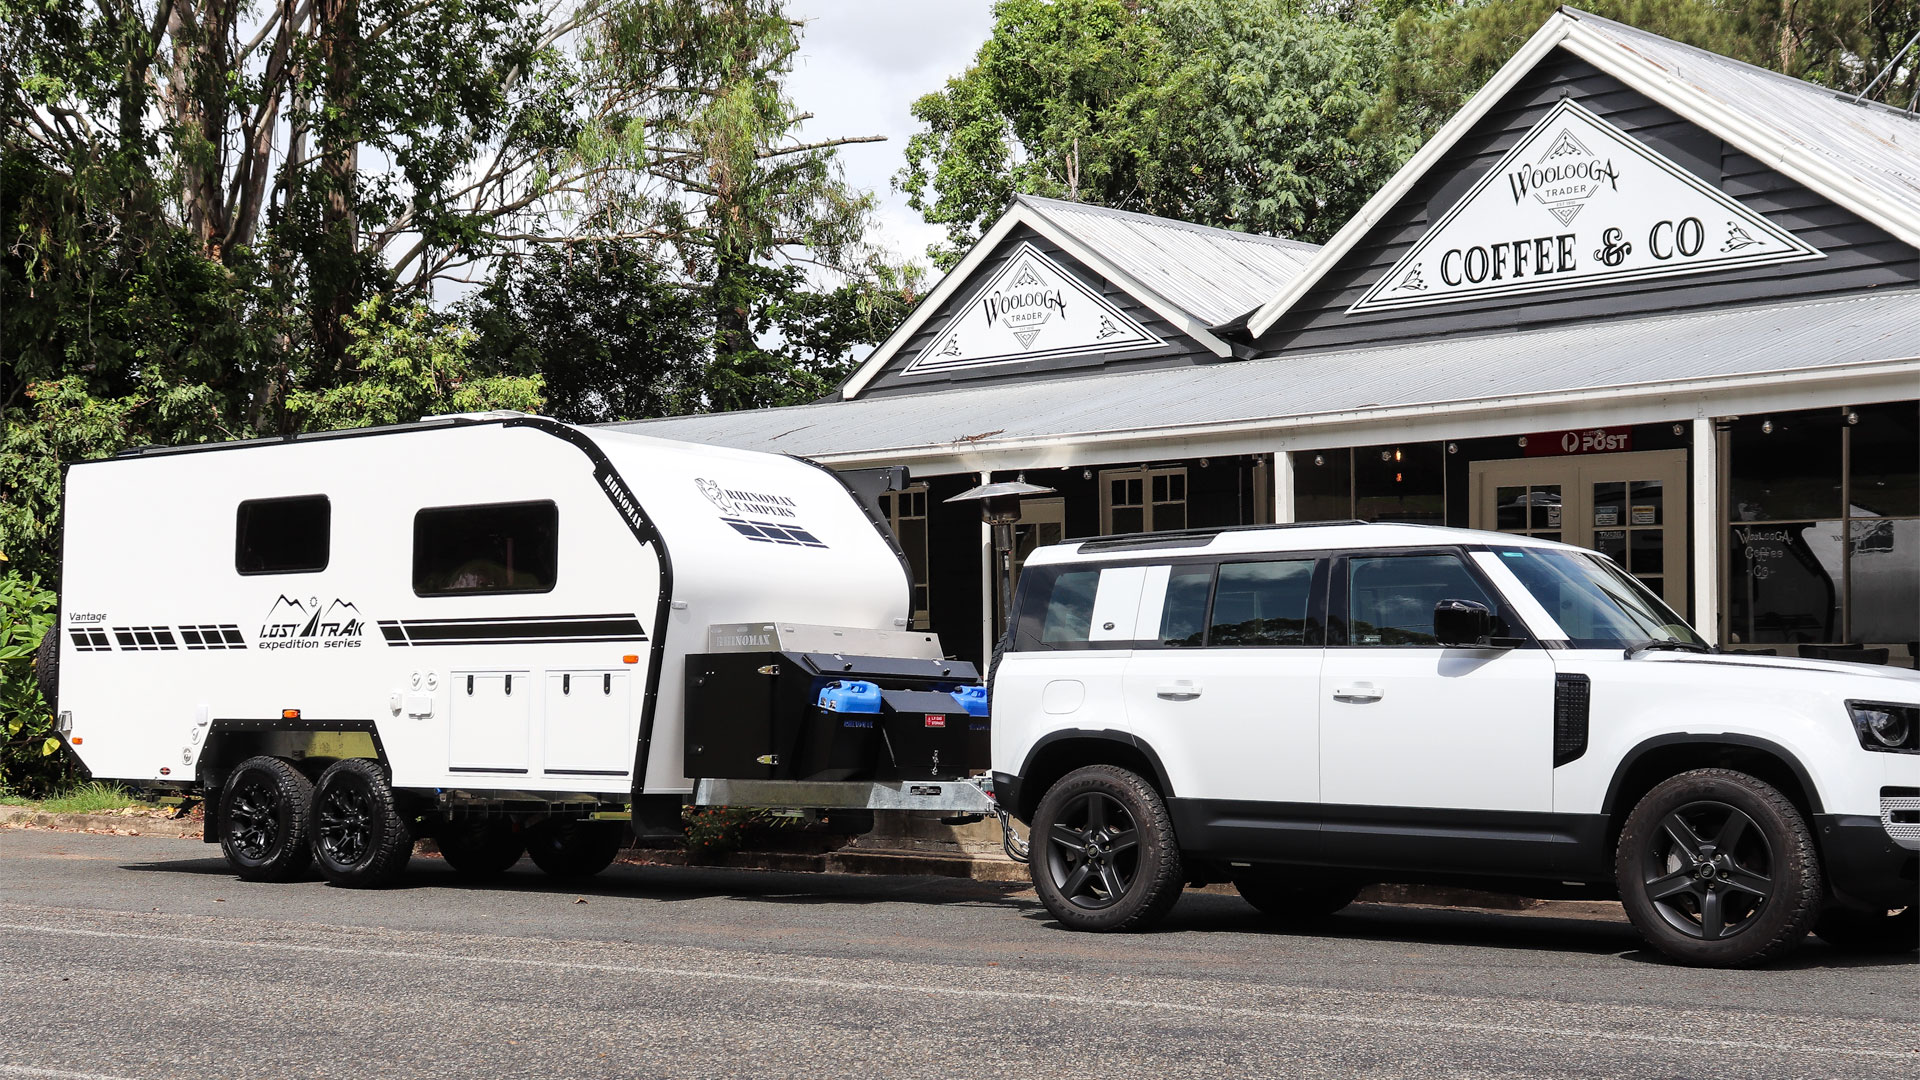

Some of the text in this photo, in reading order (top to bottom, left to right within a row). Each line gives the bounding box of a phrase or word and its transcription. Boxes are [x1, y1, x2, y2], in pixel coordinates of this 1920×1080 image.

[1508, 158, 1620, 206] WOOLOOGA
[1546, 185, 1587, 197] TRADER
[1440, 216, 1705, 286] COFFEE & CO
[983, 289, 1067, 328] WOOLOOGA
[1011, 312, 1043, 322] TRADER
[1583, 434, 1628, 451] POST
[604, 473, 644, 530] RHINOMAX
[725, 489, 797, 507] RHINOMAX
[734, 501, 796, 518] CAMPERS
[69, 612, 107, 624] Vantage
[259, 618, 366, 638] LOST TRAK
[258, 638, 362, 651] expedition series
[716, 634, 770, 647] RHINOMAX
